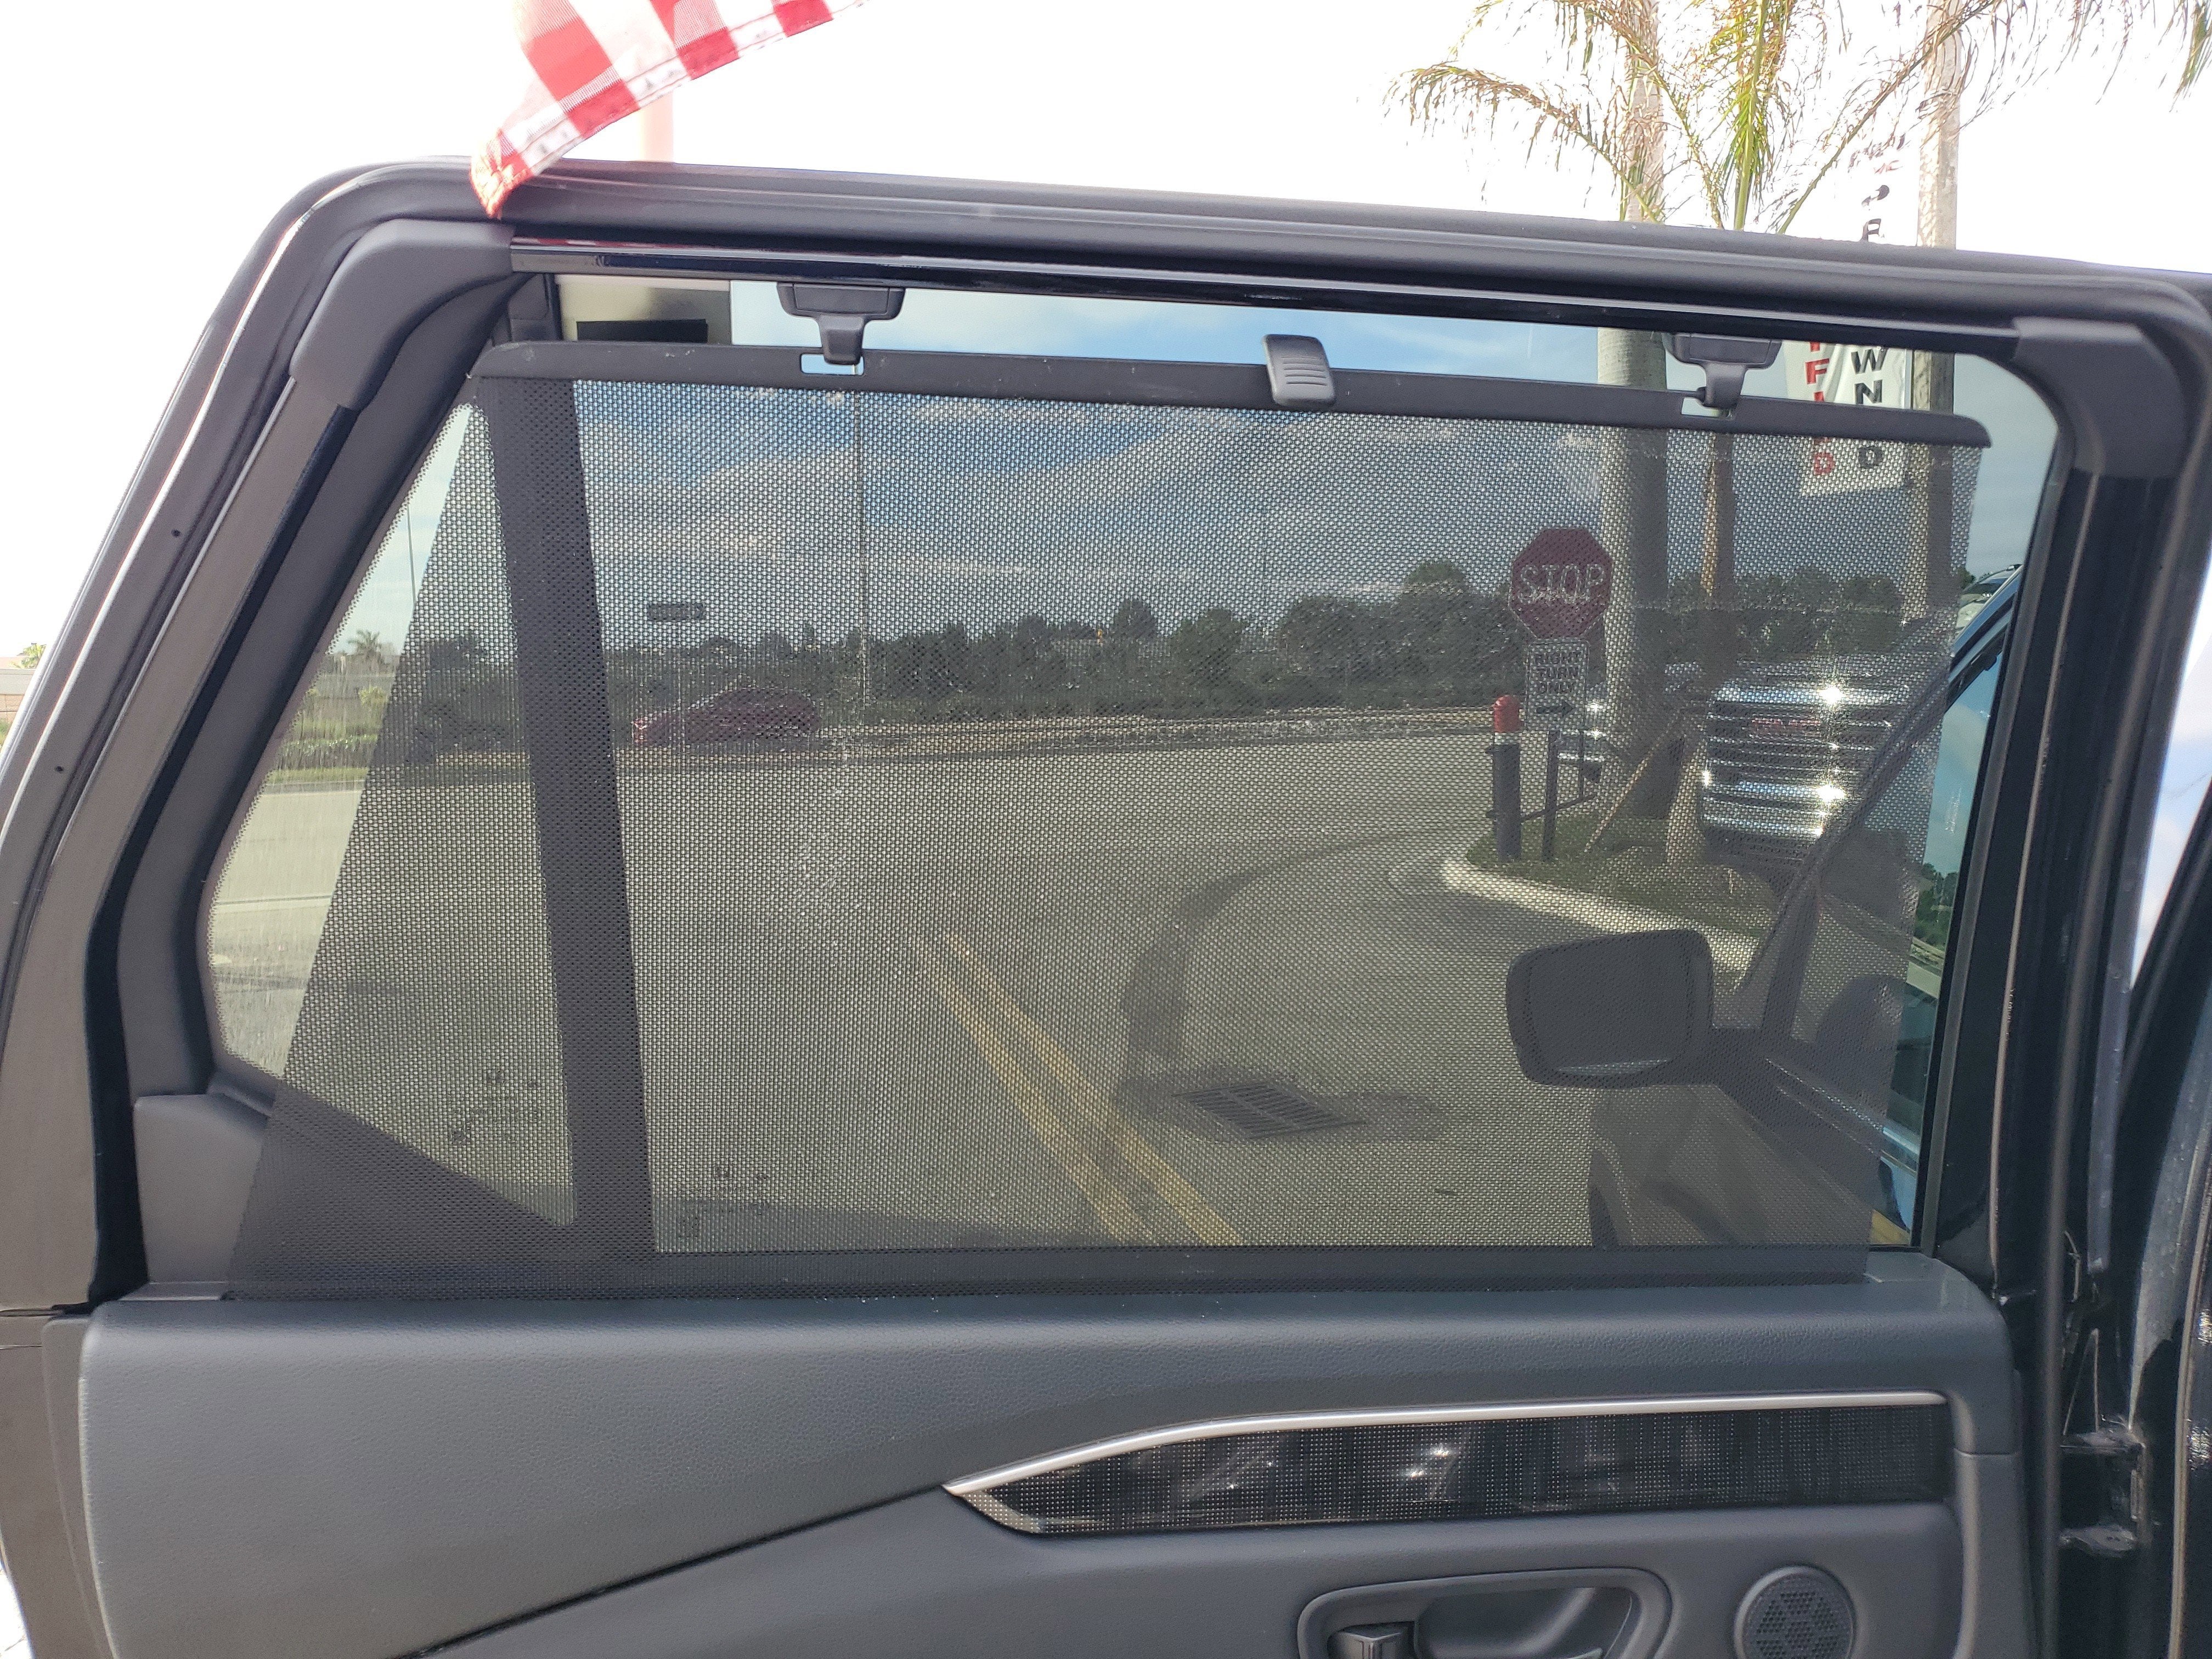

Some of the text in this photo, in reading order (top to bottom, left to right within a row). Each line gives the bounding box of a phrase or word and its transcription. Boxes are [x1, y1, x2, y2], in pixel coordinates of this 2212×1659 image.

[1520, 563, 1605, 605] STOP
[1534, 651, 1581, 664] RIGHT
[1537, 667, 1578, 679] TURN
[1537, 682, 1576, 694] ONLY
